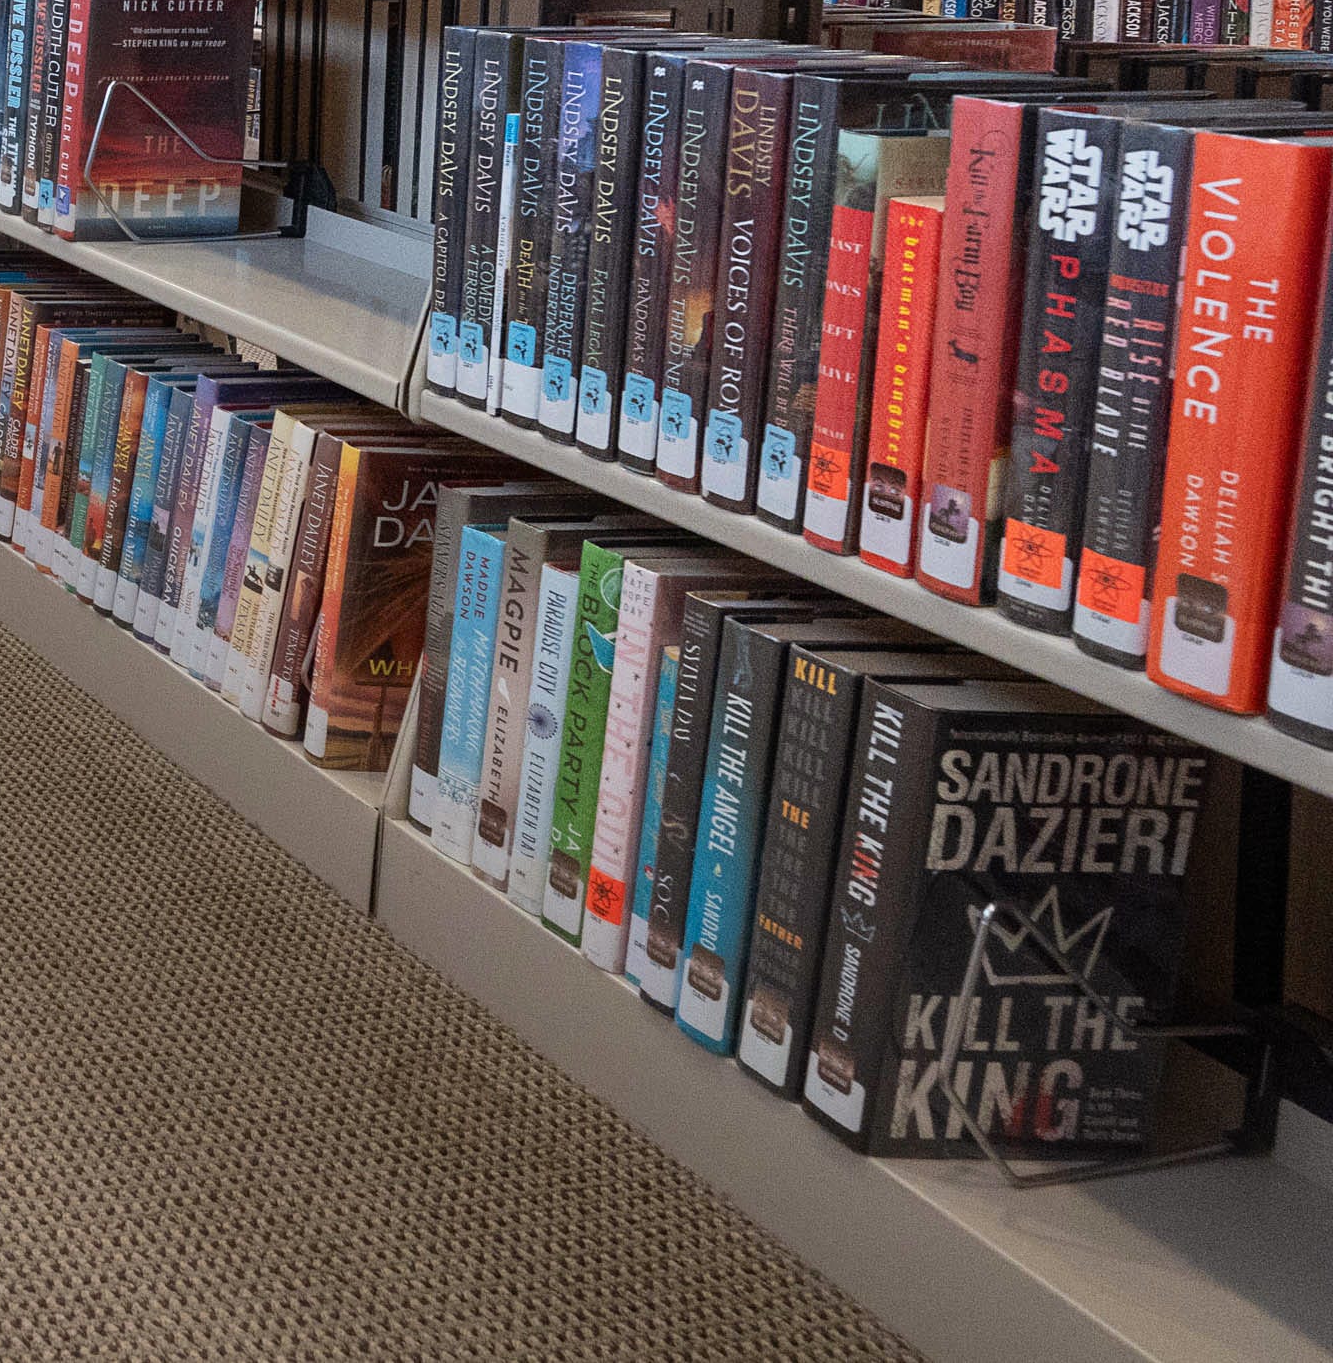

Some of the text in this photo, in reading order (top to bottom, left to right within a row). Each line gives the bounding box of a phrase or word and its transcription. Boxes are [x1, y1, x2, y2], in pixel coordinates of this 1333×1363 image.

[123, 0, 225, 13] NICK CUTTER
[1124, 1, 1141, 38] JACKSON
[43, 60, 62, 127] CUTLER
[67, 20, 83, 97] DEEP
[437, 49, 461, 197] LINDSEY DAVIS
[474, 58, 499, 214] LINDSEY DAVIS
[520, 58, 547, 218] LINDSEY DAVIS
[556, 71, 583, 236] LINDSEY DAVIS
[728, 89, 759, 200] DAVIS
[97, 176, 223, 219] DEEP
[673, 107, 704, 285] LINDSEY DAVIS
[783, 101, 820, 289] LINDSEY DAVIS
[1038, 128, 1104, 243] STAR WARS
[724, 219, 755, 350] VOICES OF
[1184, 177, 1243, 425] VIOLENCE
[1242, 279, 1279, 344] THE
[1029, 252, 1082, 475] PHASMA
[1093, 296, 1132, 457] RED BLADE
[1180, 474, 1205, 567] DAWSON
[1217, 469, 1240, 565] DELILAH
[459, 550, 477, 621] DAWSON
[473, 556, 491, 620] MADDIE
[499, 546, 531, 674] MAGPIE
[537, 589, 568, 698] PARADISE CITY
[794, 657, 838, 696] KILL
[559, 593, 600, 819] BLOCK PARTY
[708, 692, 753, 857] KILL THE ANGEL
[780, 798, 811, 830] THE
[846, 700, 905, 907] KILL THE KING
[937, 748, 1207, 808] SANDRONE
[925, 802, 1196, 877] DAZIERI
[757, 912, 804, 950] FATHER
[833, 943, 862, 1025] SANDRONE
[902, 994, 1145, 1052] KILL THE
[889, 1058, 1084, 1142] KING
